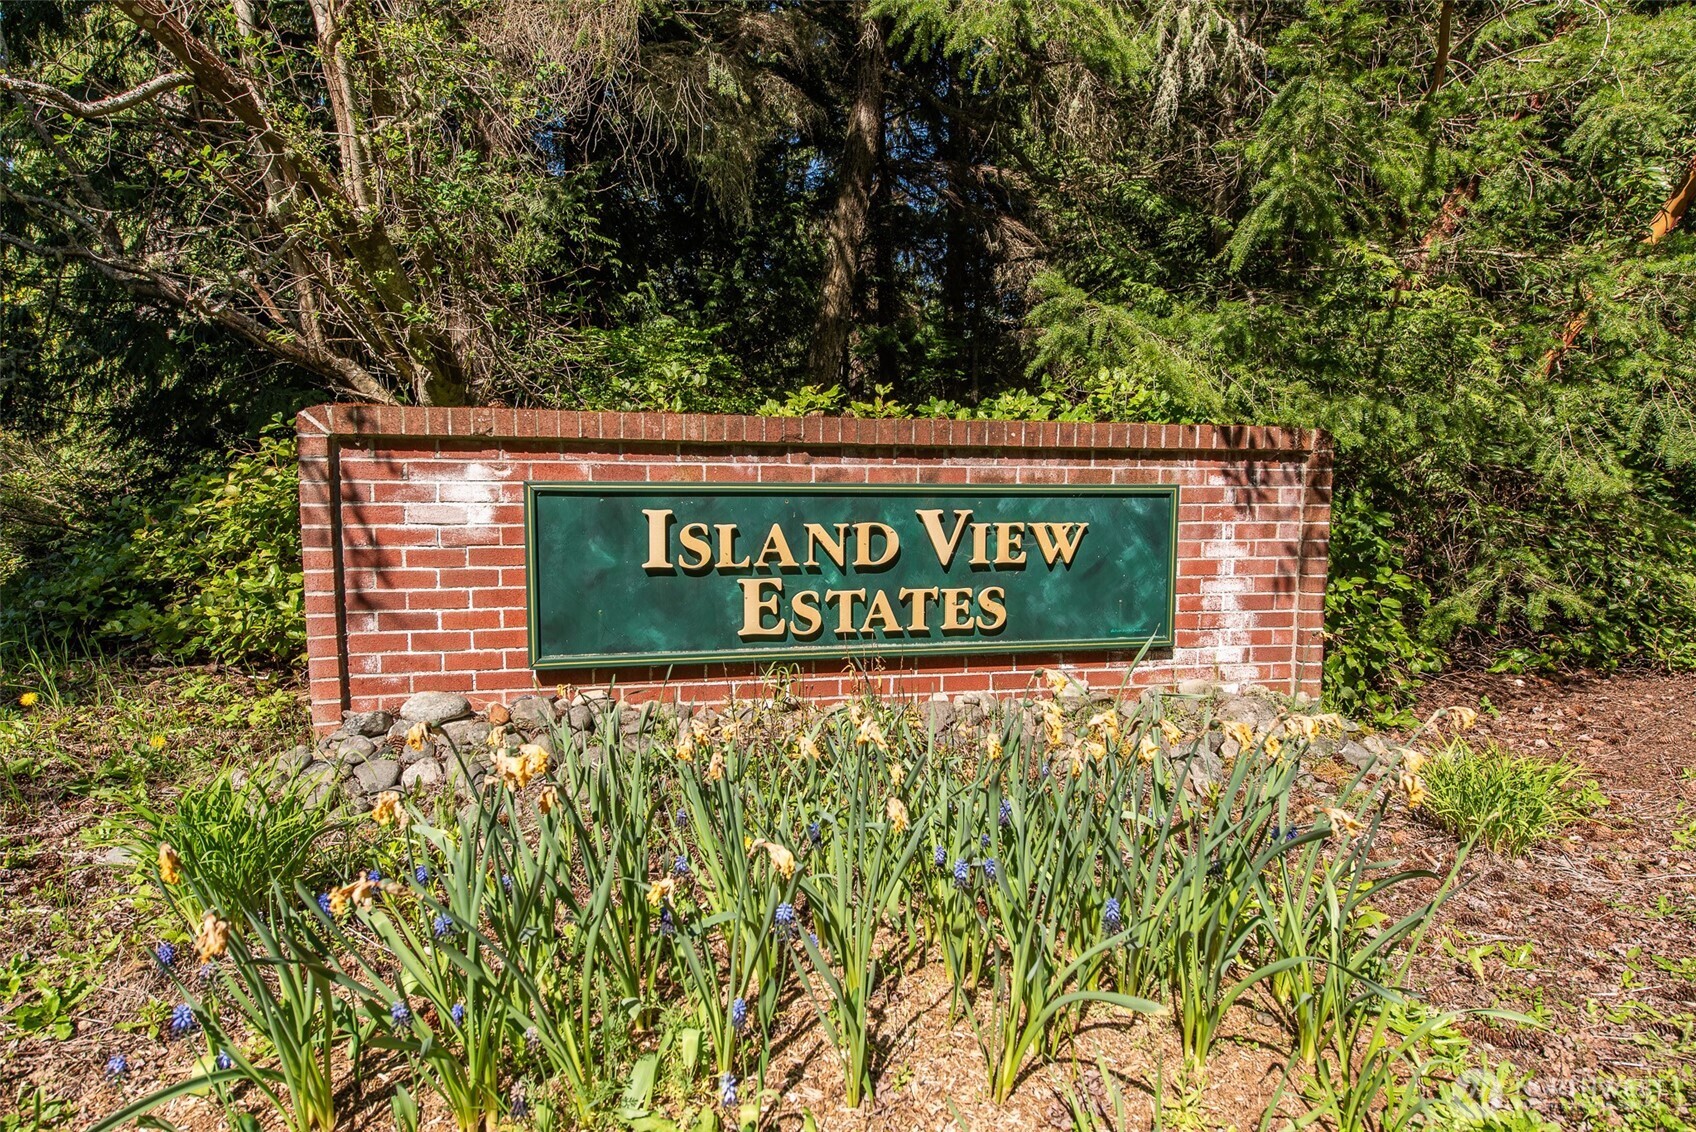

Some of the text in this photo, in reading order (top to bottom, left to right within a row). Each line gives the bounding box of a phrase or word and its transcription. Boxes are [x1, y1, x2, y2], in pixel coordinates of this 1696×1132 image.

[641, 508, 1090, 570] ISLAND VIEW
[736, 577, 1008, 637] ESTATES
